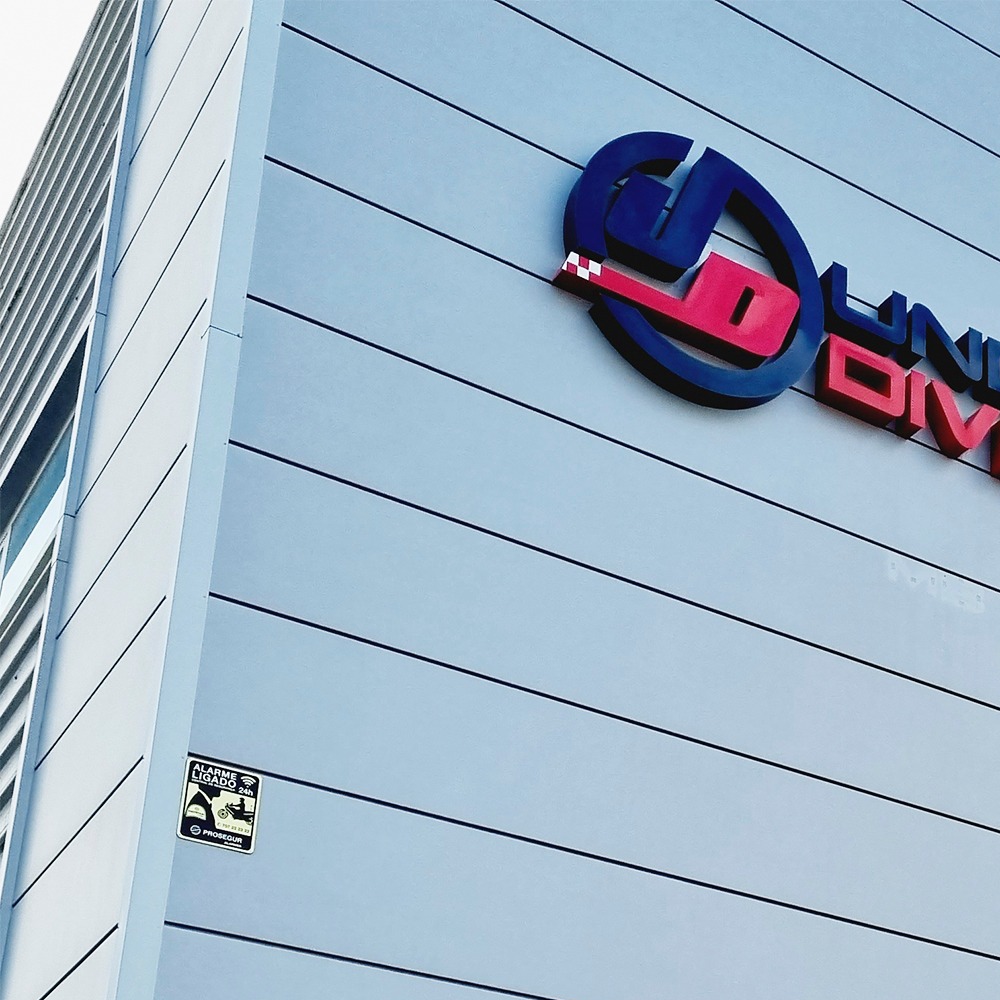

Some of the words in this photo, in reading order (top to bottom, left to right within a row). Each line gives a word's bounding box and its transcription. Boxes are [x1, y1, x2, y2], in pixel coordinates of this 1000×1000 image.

[192, 770, 237, 789] LIGADO
[193, 763, 237, 781] ALARME
[238, 787, 254, 797] 24h
[202, 829, 243, 844] PROSEGUR
